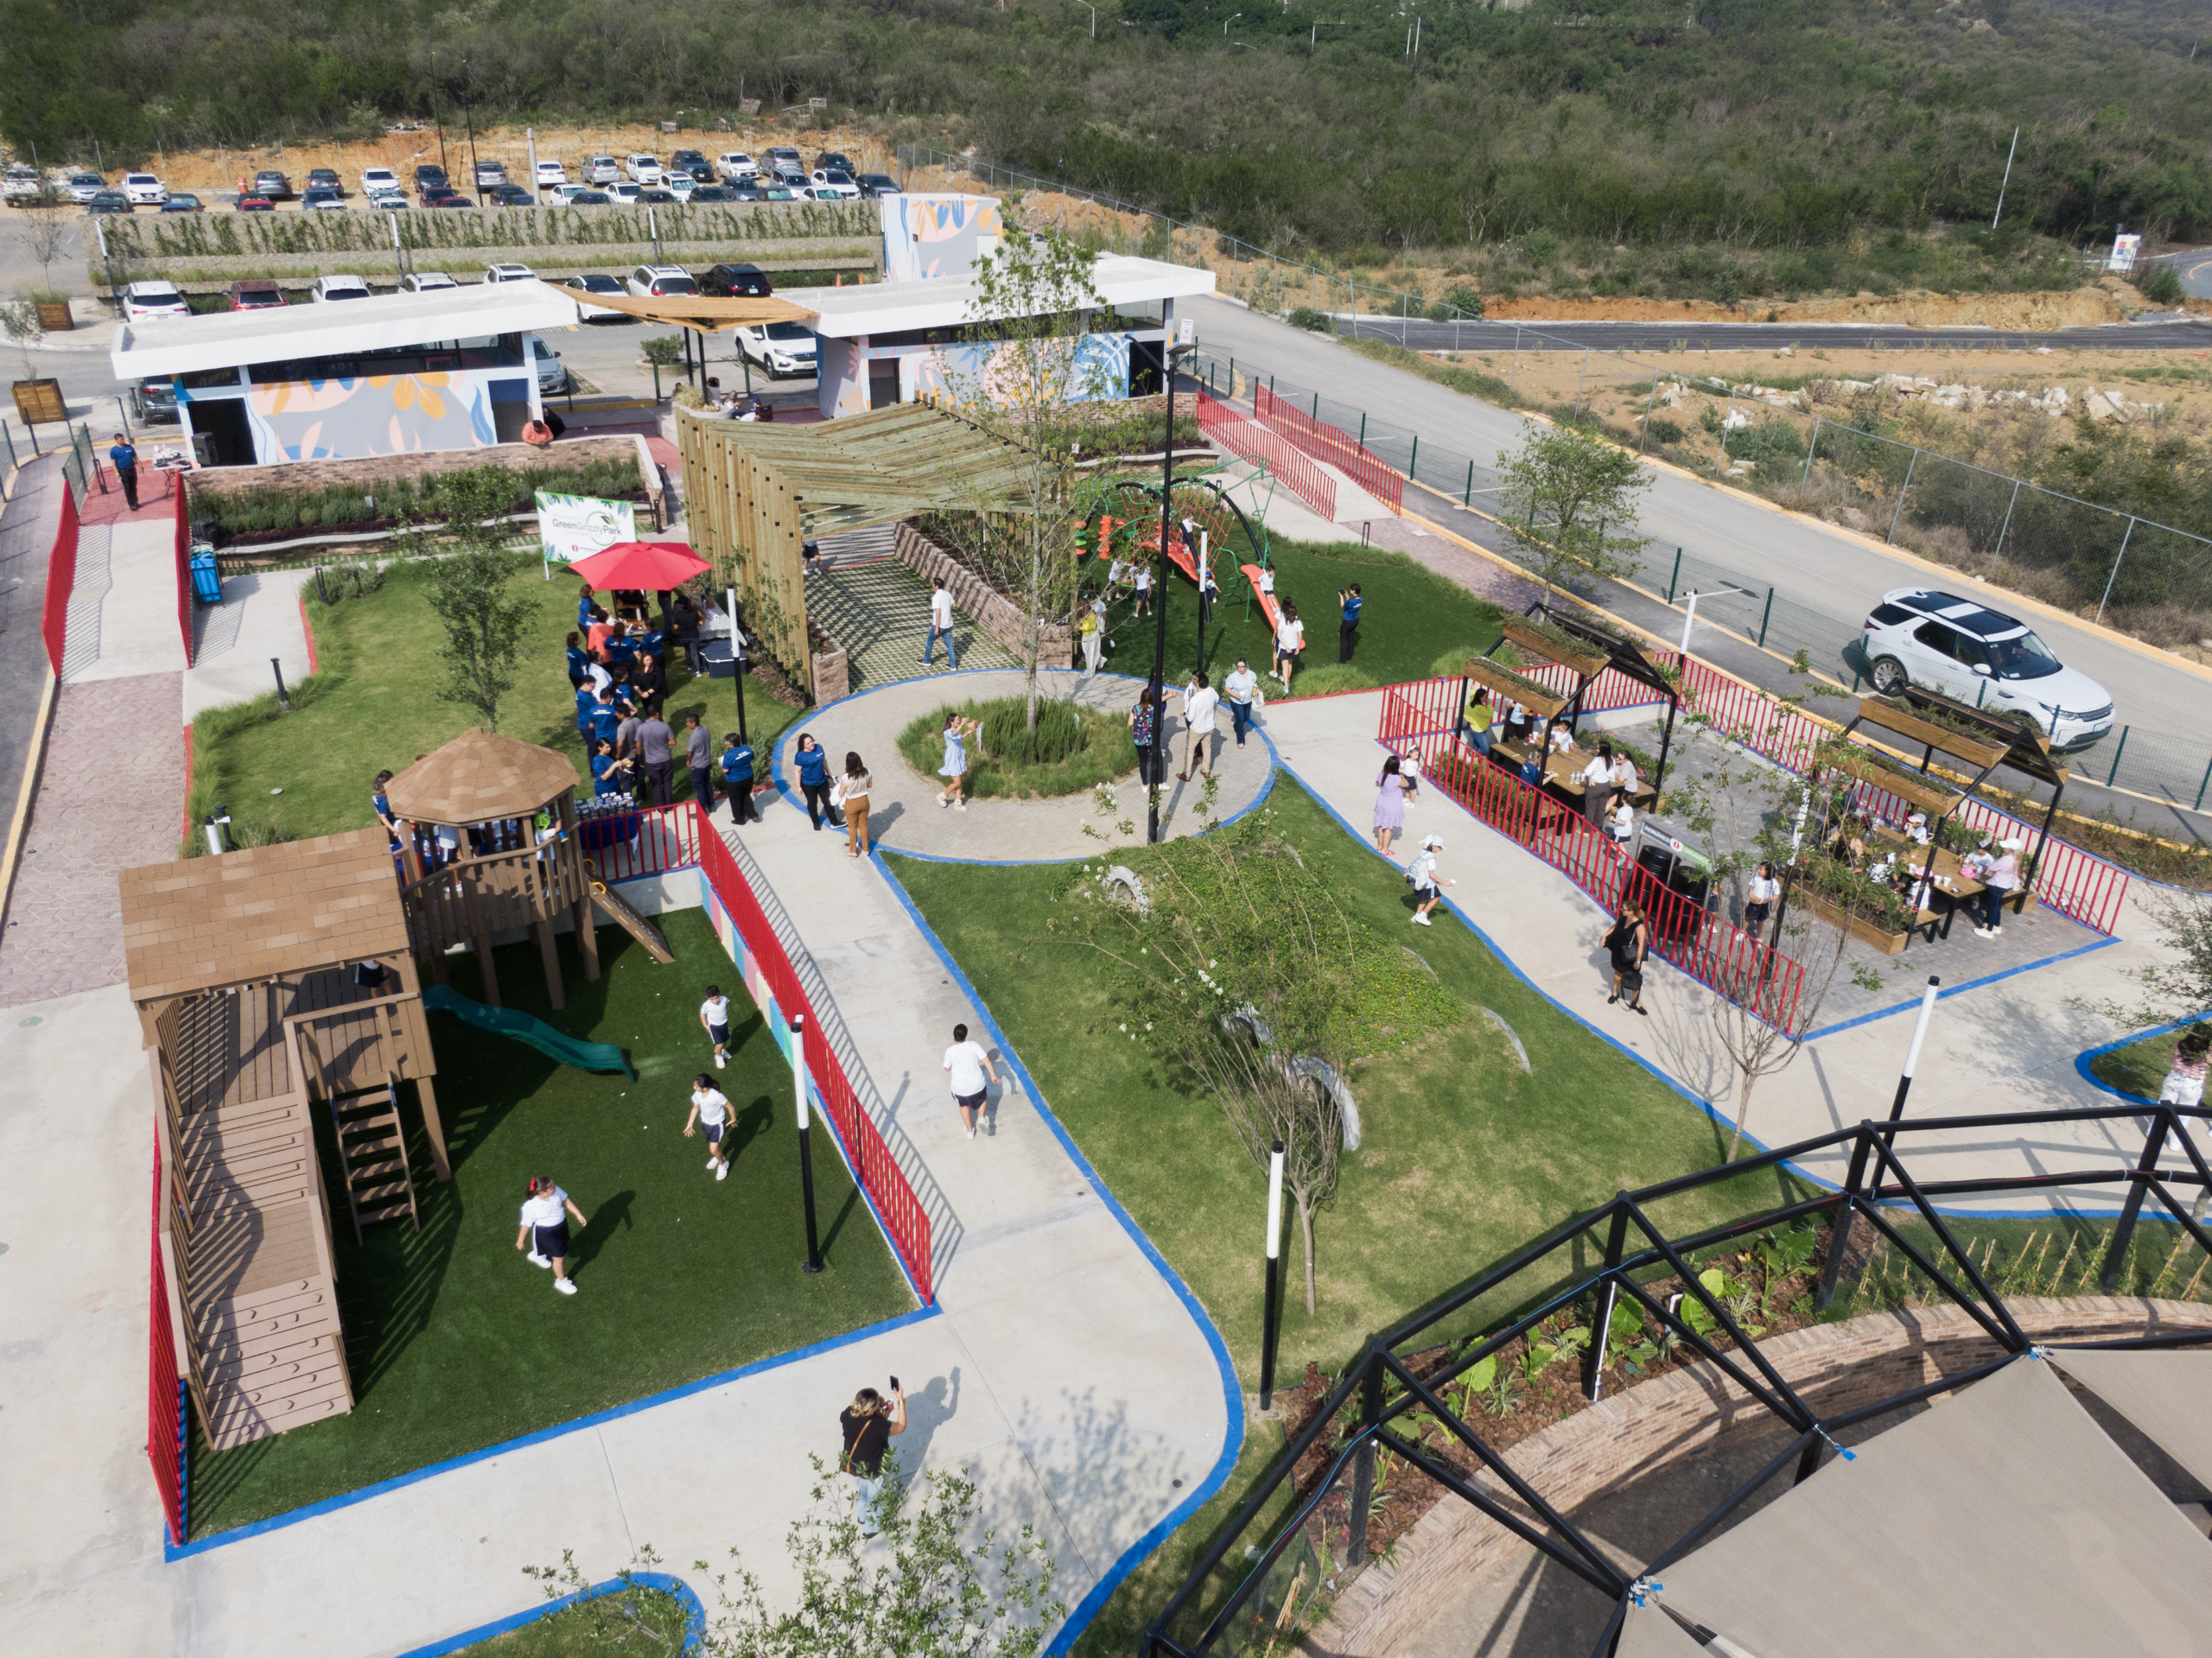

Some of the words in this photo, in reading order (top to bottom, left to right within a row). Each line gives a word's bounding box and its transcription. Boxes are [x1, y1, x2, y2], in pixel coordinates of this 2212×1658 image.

[552, 518, 622, 536] GreenGrizzlyPark
[1643, 825, 1670, 843] INORGÁNICO
[1683, 848, 1709, 865] ORGÁNICO
